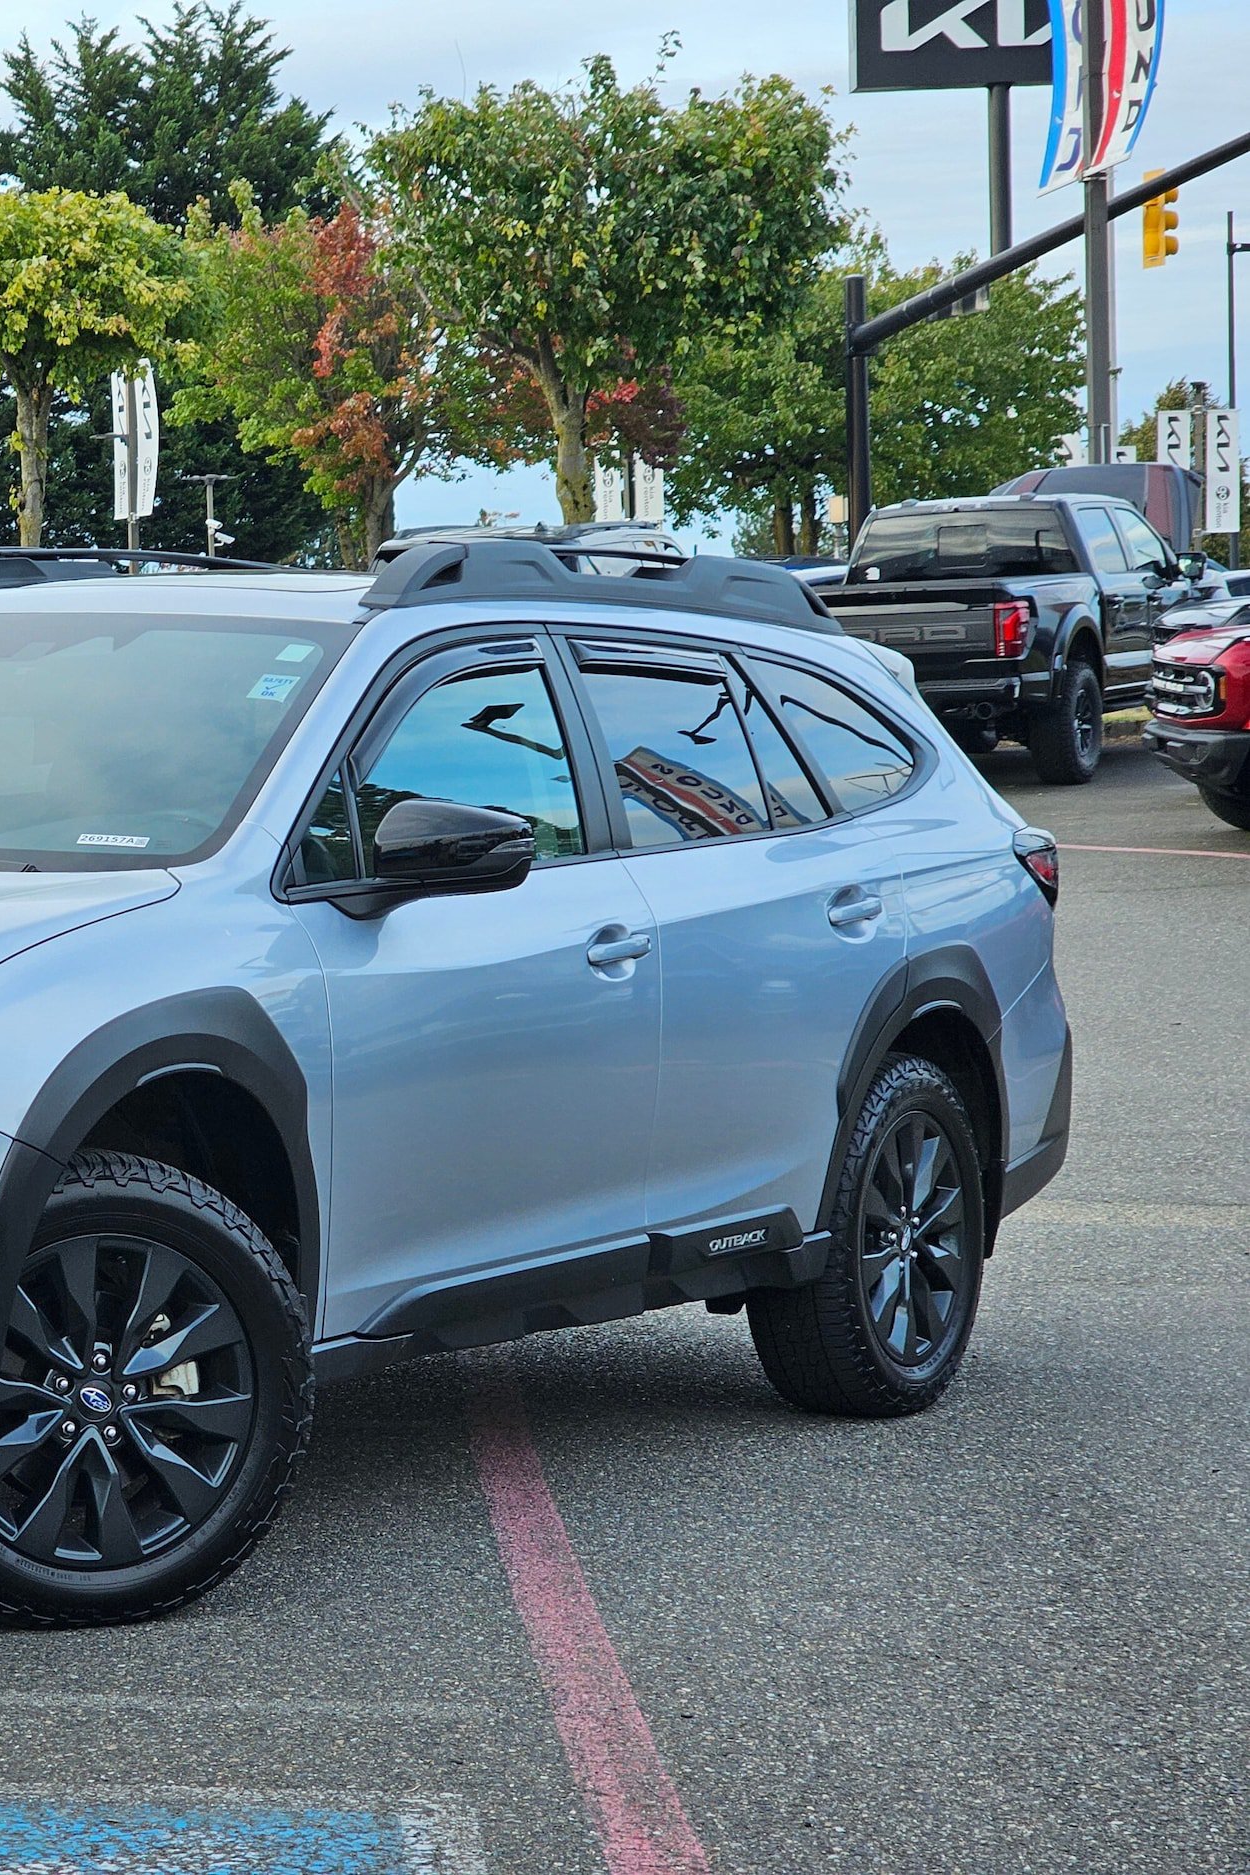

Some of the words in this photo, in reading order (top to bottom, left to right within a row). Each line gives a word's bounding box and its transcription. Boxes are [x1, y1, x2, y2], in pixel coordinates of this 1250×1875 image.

[1215, 415, 1230, 472] KIA
[262, 677, 294, 685] SAFETY
[81, 834, 135, 844] 269157A
[709, 1229, 767, 1252] OUTBACK
